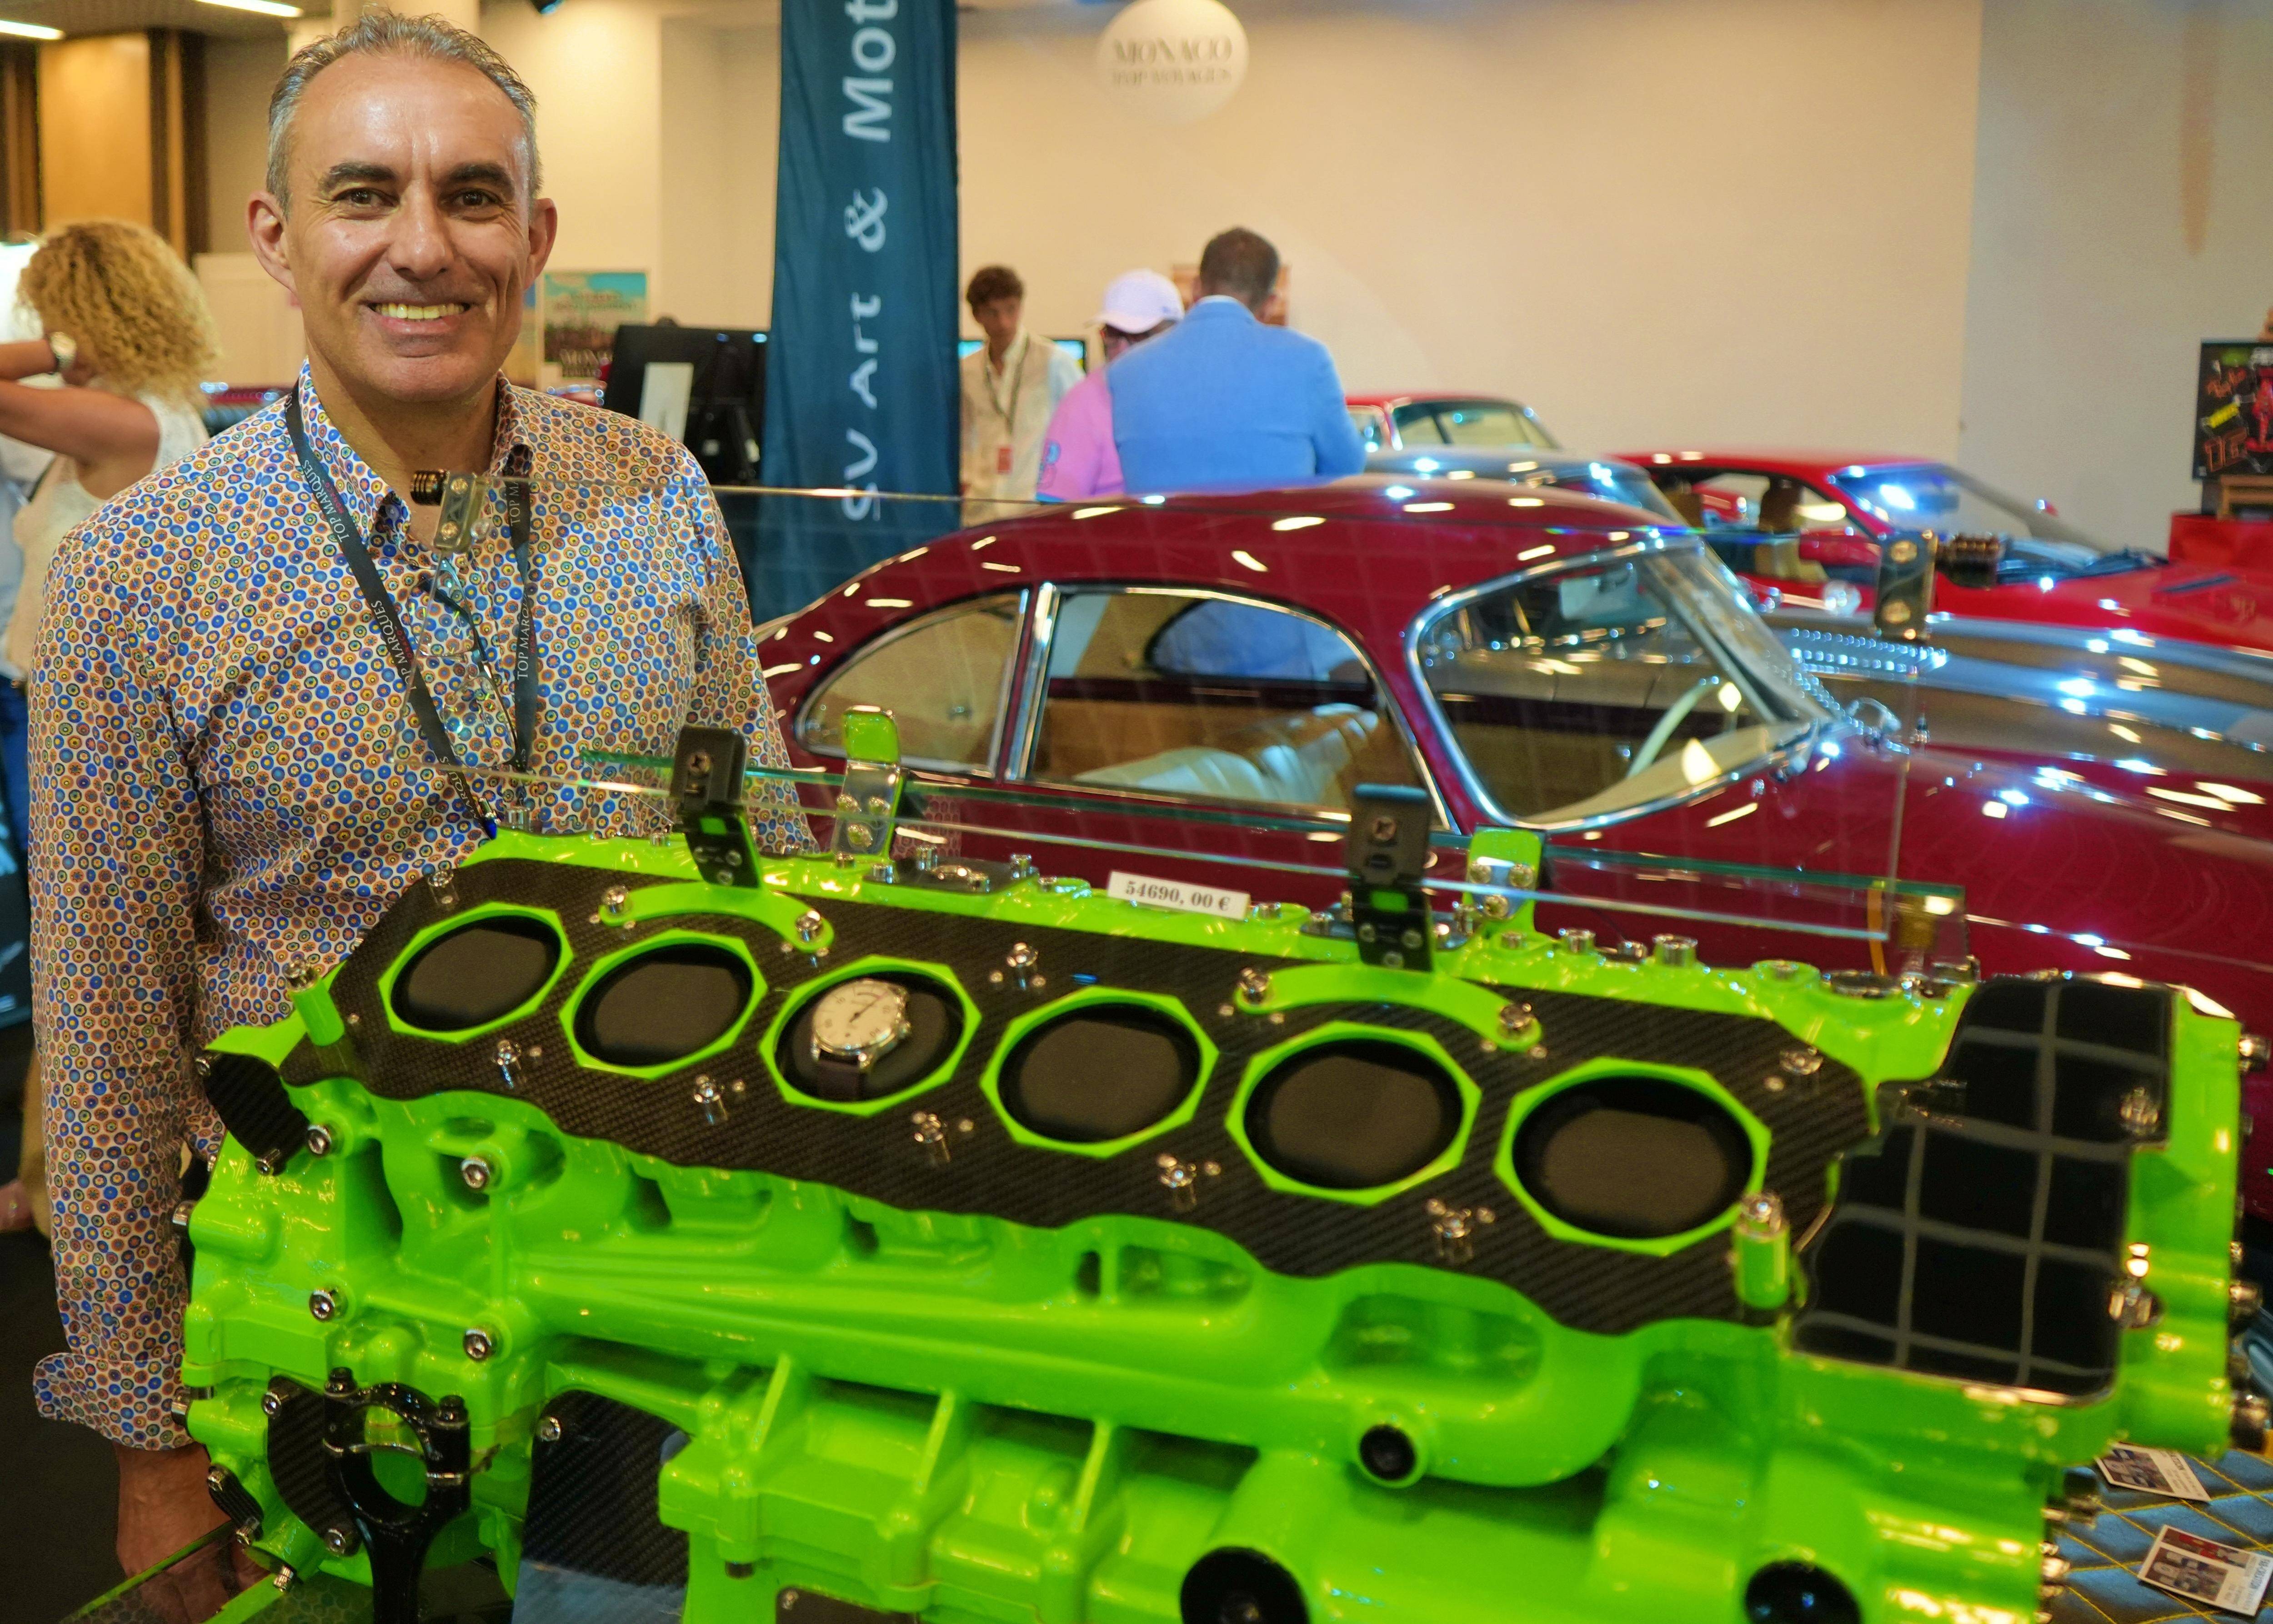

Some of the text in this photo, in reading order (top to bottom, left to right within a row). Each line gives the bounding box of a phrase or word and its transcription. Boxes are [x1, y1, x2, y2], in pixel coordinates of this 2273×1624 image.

[1113, 36, 1232, 64] MONACO
[844, 186, 888, 253] &
[850, 292, 881, 410] Art
[303, 460, 349, 542] TOP MARQUES
[510, 500, 521, 526] TOP
[371, 600, 408, 664] MARQUES
[517, 652, 529, 680] TOP
[1218, 896, 1231, 911] €
